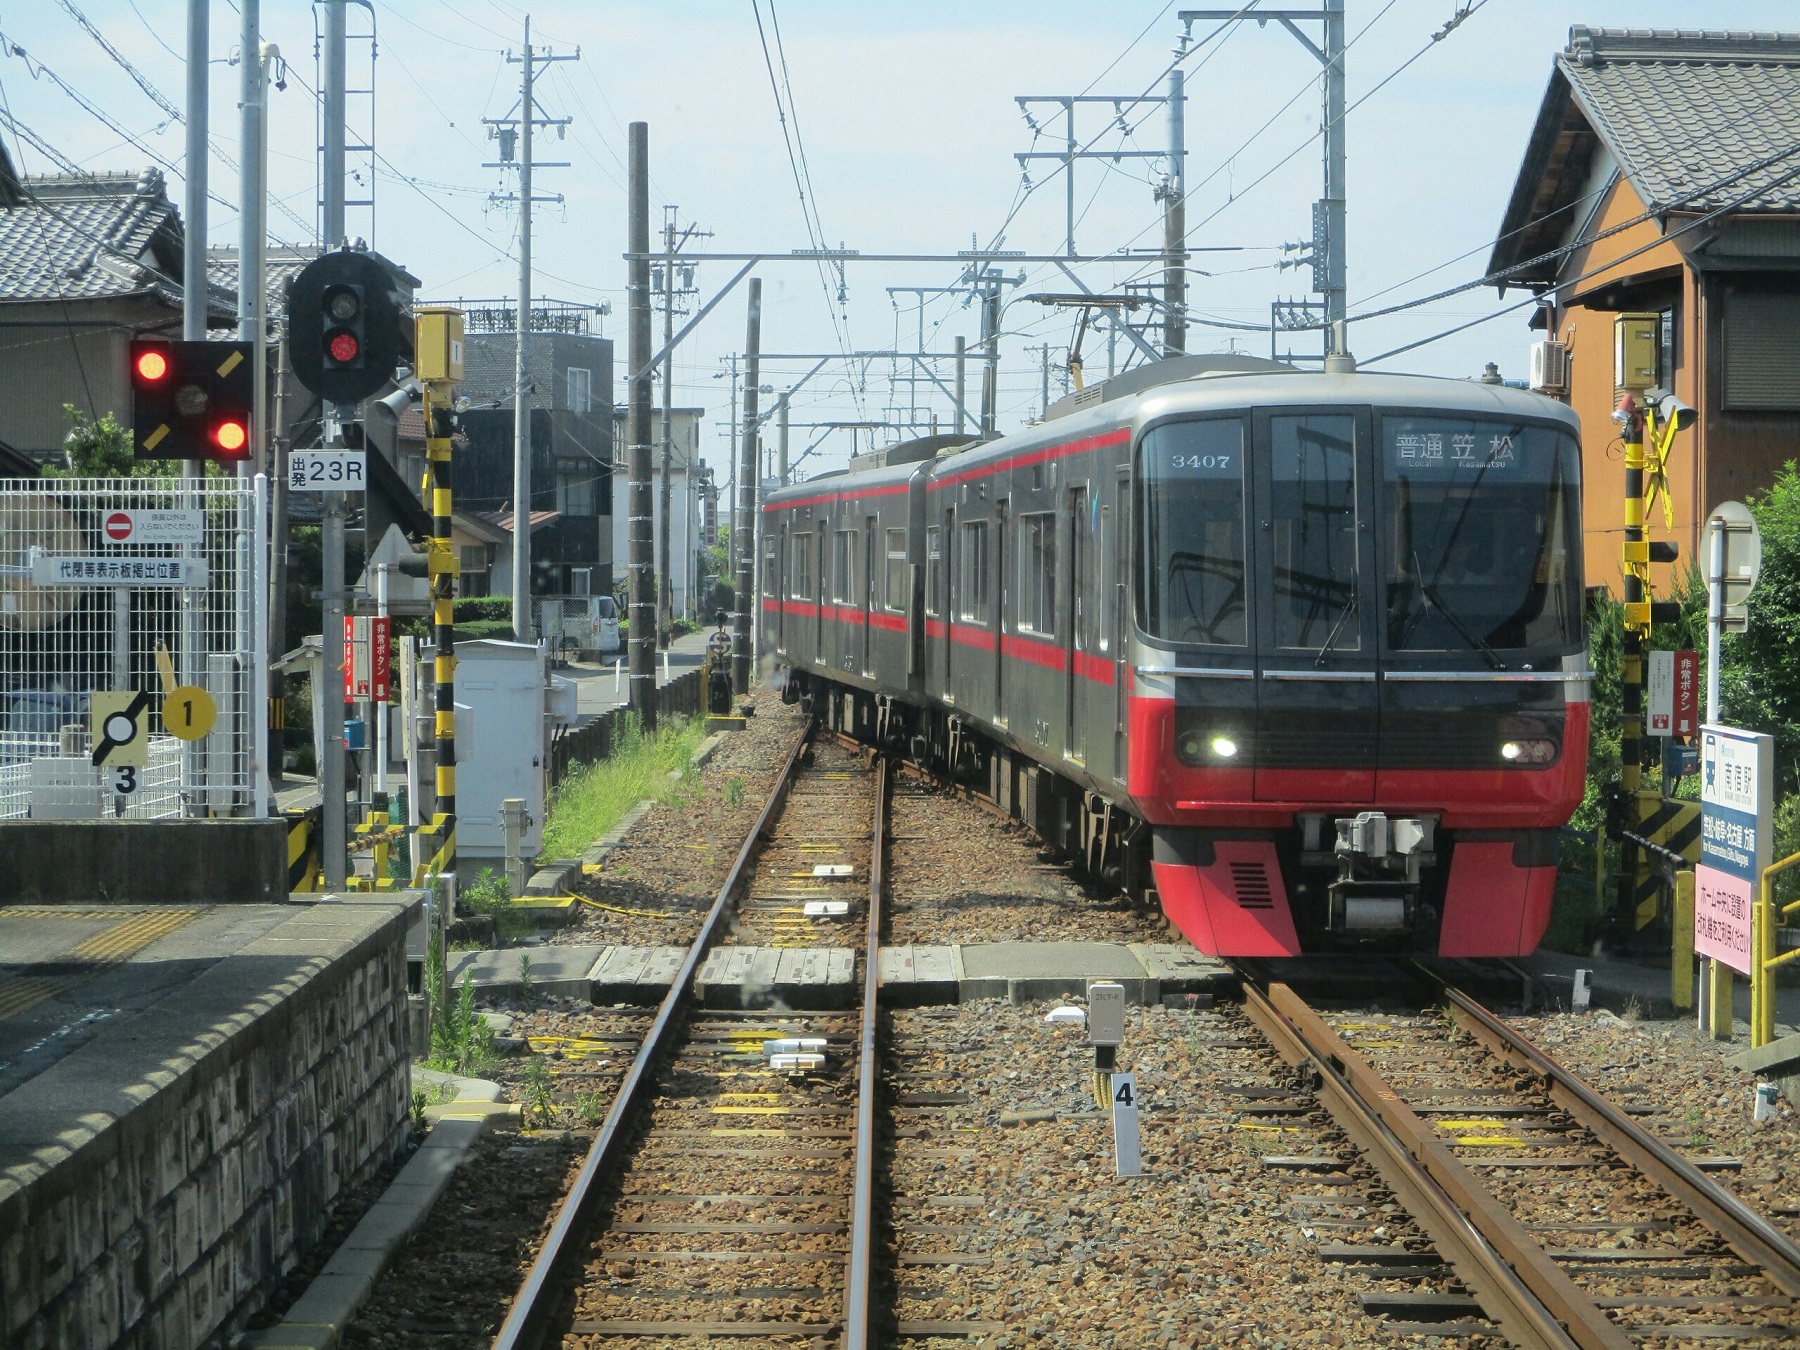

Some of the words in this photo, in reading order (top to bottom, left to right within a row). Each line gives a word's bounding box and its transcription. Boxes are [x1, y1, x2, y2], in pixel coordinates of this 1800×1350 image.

[1396, 433, 1443, 459] 普通
[291, 457, 306, 487] 出発
[310, 460, 362, 481] 23R
[1172, 455, 1230, 469] 3407
[1408, 459, 1432, 468] Local
[1459, 459, 1506, 468] Kasamatsu
[139, 522, 200, 530] 入らないでください
[60, 561, 180, 579] 代閉等表示板掲出位置
[376, 622, 386, 676] 非常ボタン
[1680, 659, 1691, 711] 非常ボタン
[182, 700, 192, 727] 1
[115, 765, 137, 794] 3
[1724, 761, 1752, 795] 南宿駅
[1697, 911, 1749, 954] 改札機をご利用ください
[1115, 1082, 1134, 1107] 4
